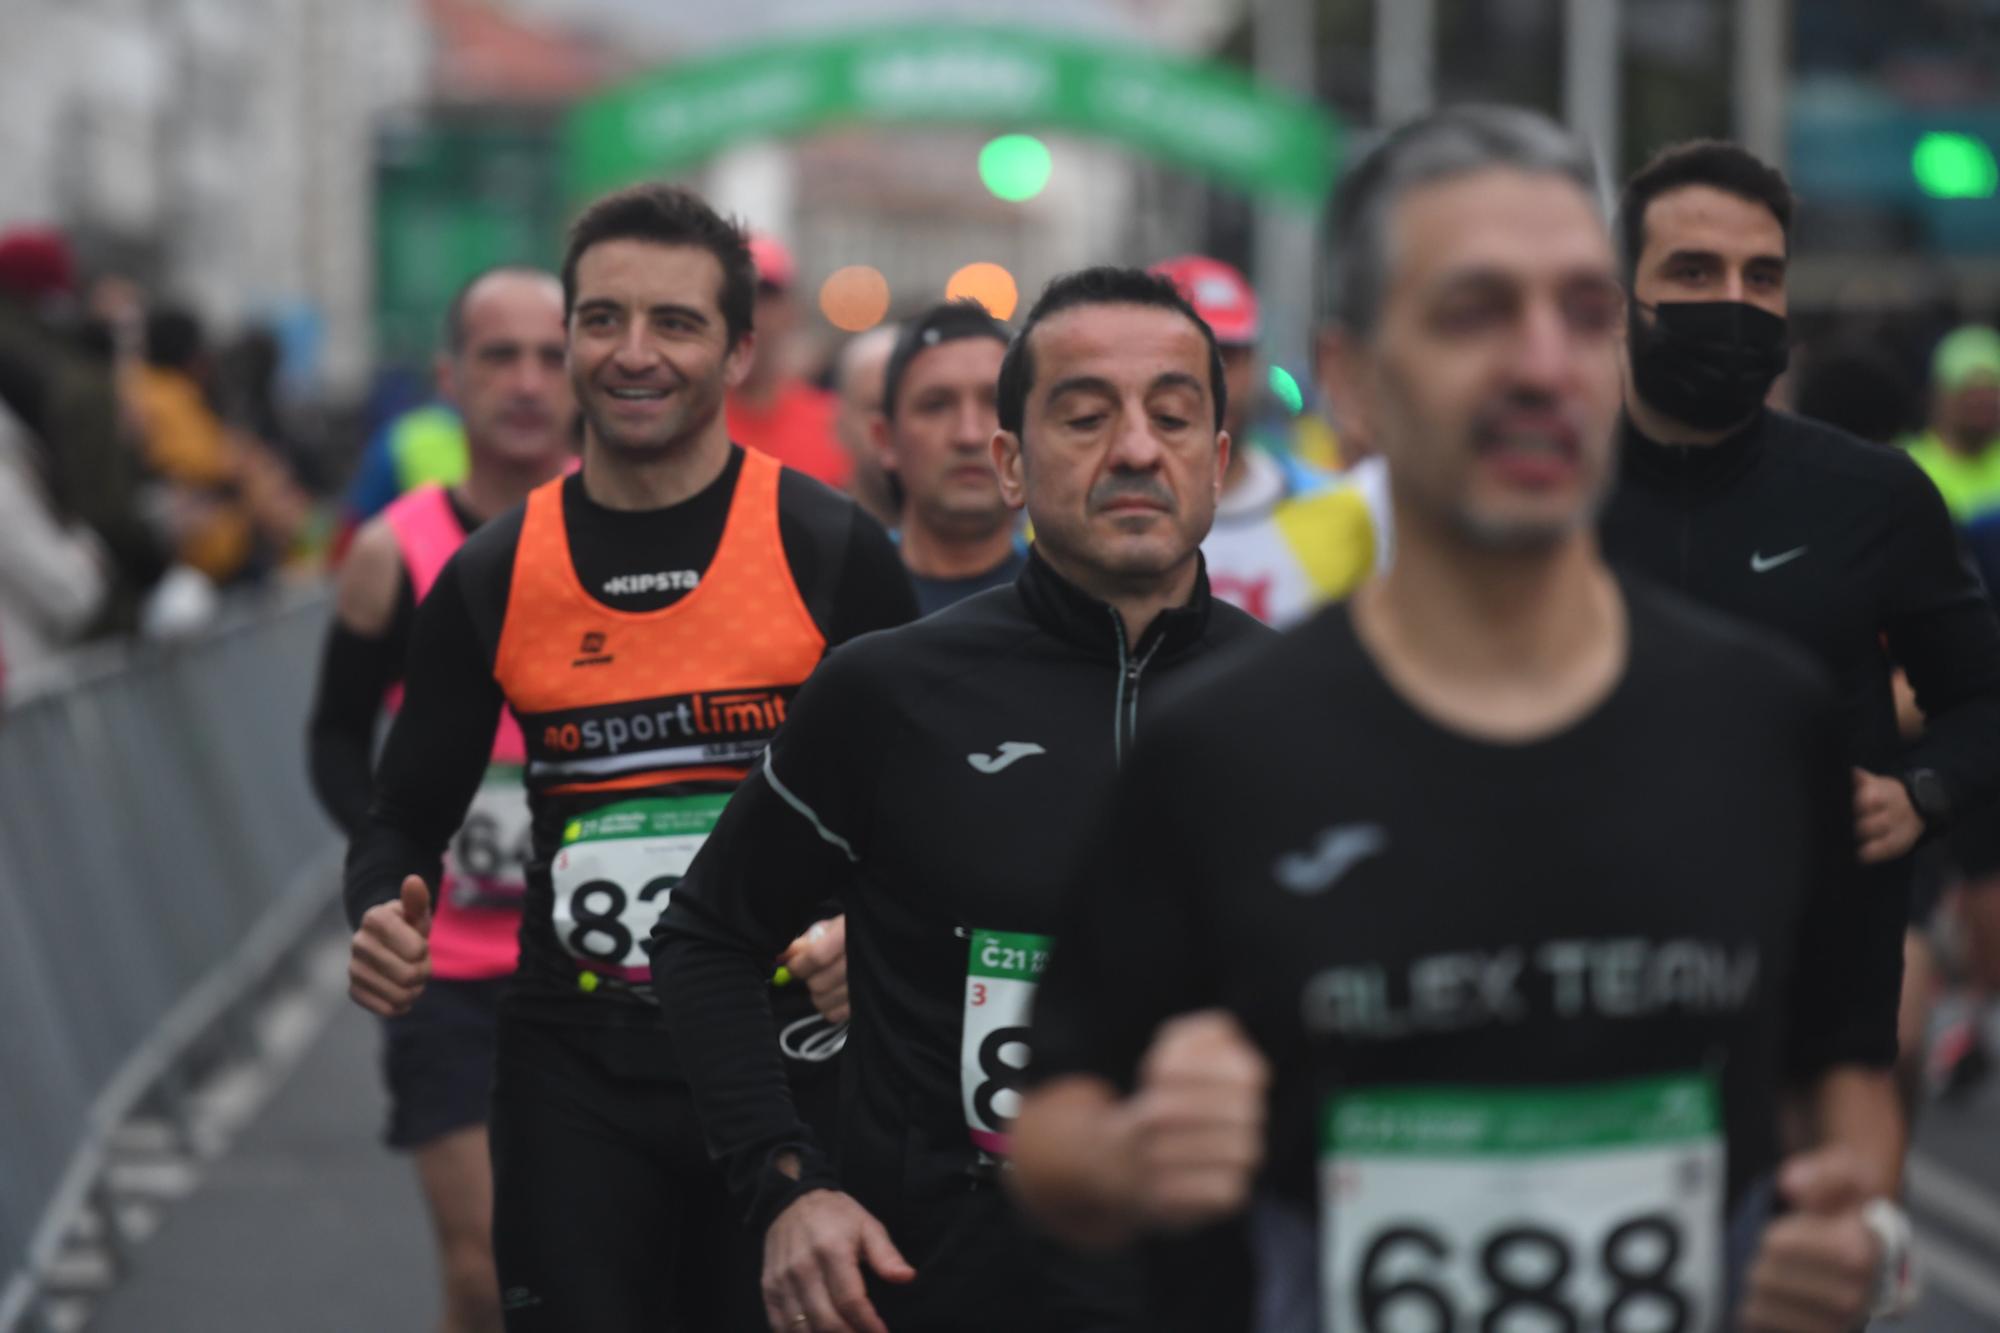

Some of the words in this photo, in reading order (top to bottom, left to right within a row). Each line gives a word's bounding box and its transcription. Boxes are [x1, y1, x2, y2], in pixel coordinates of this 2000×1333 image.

[971, 984, 987, 1006] 3
[1302, 948, 1527, 1040] ALEX
[1536, 936, 1758, 1018] TEAM
[1357, 1214, 1688, 1333] 688
